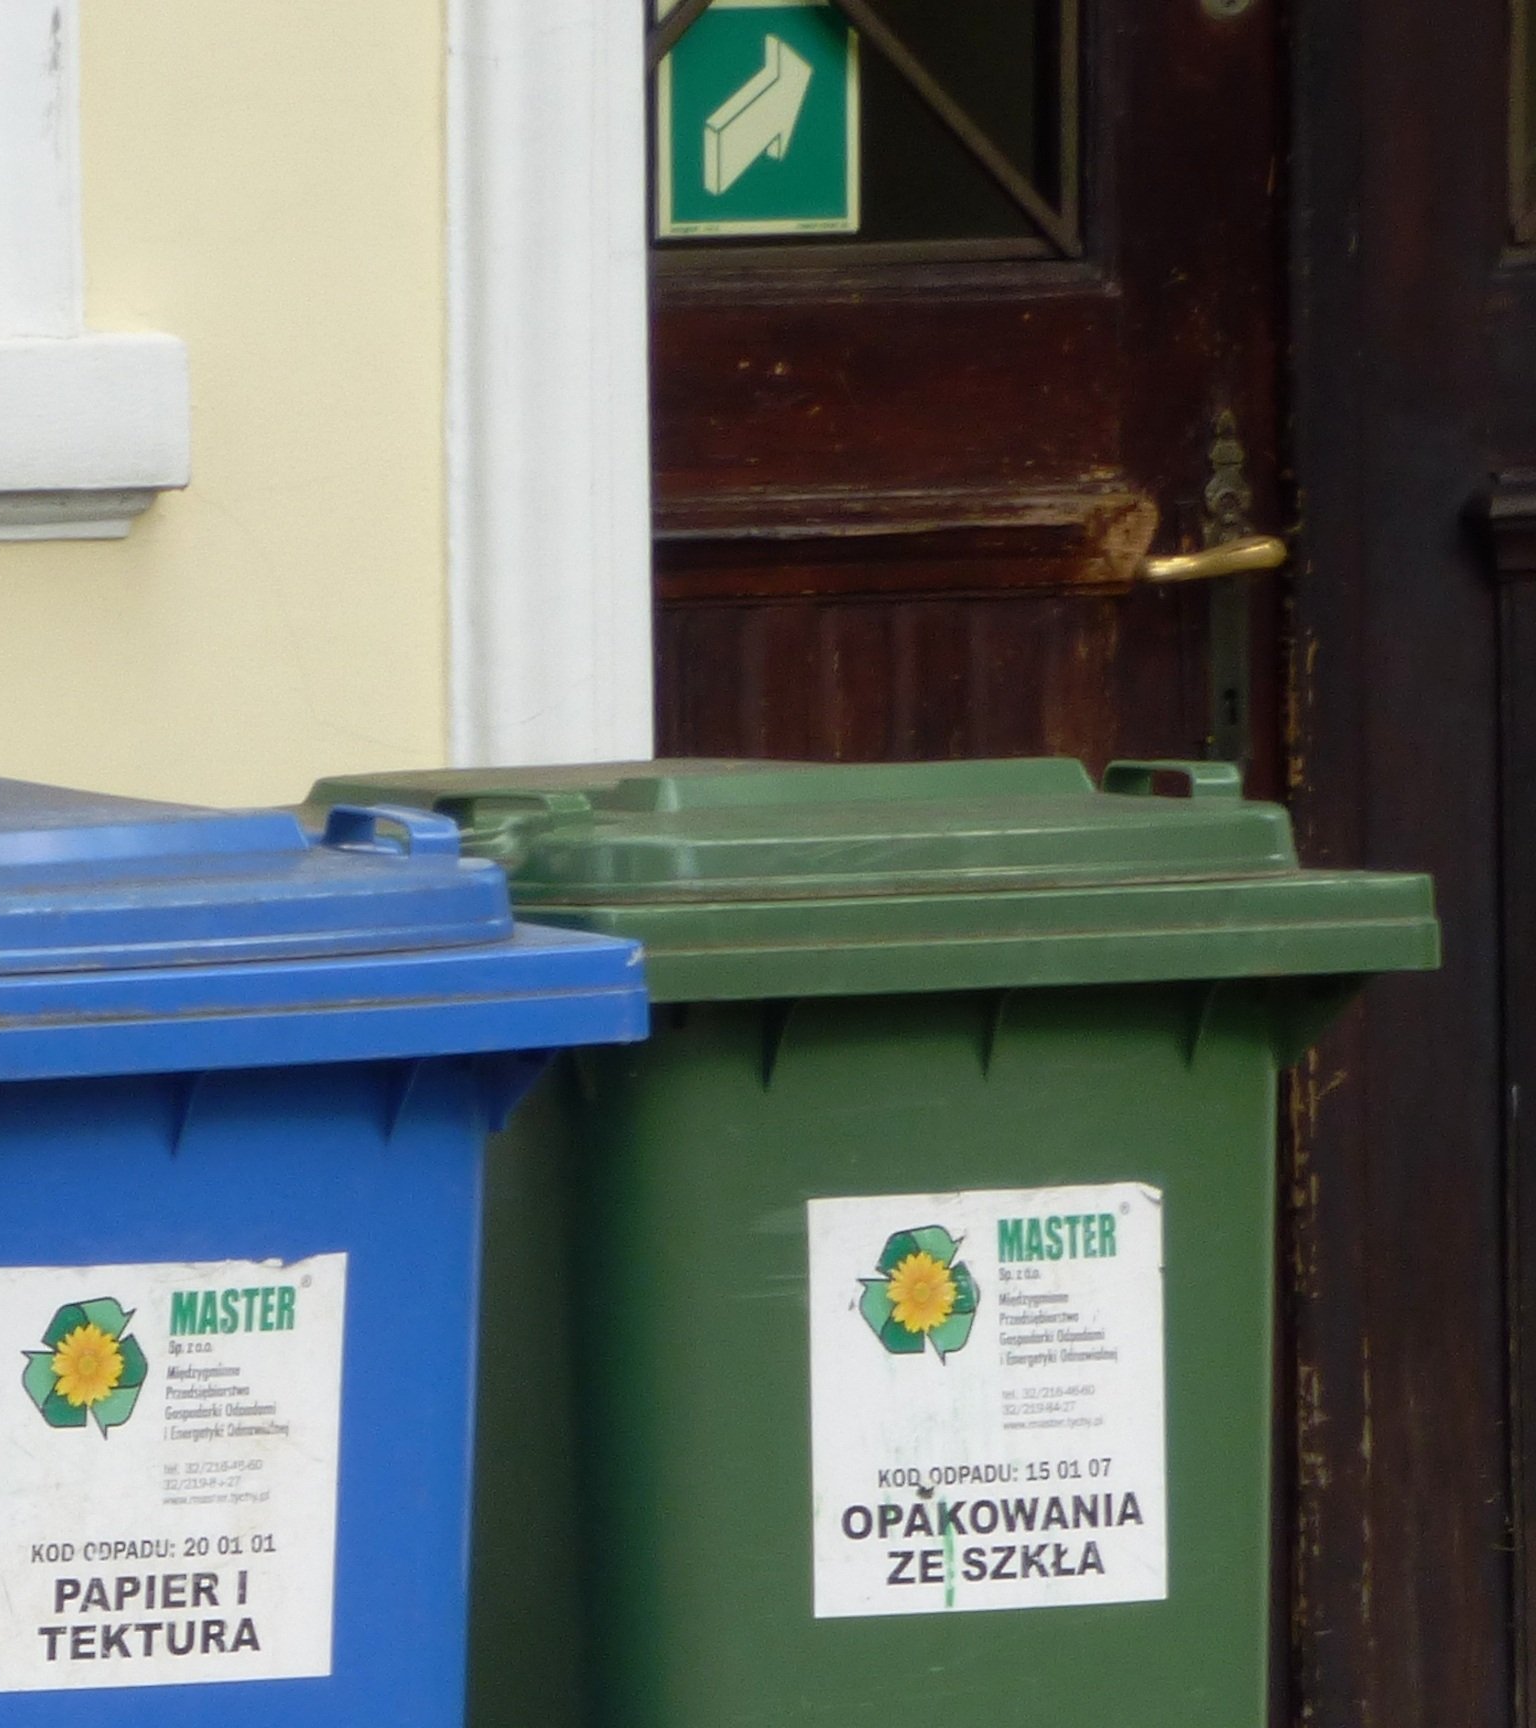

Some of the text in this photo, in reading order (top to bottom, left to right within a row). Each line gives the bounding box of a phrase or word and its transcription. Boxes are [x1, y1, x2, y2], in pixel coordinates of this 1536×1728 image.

[998, 1213, 1116, 1262] MASTER
[170, 1286, 296, 1336] MASTER
[878, 1458, 1112, 1488] KOD ODPADU: 15 01 07
[841, 1491, 1144, 1540] OPAKOWANIA
[32, 1534, 276, 1563] KOD ODPADU: 20 01 01
[886, 1540, 1106, 1585] ZE SZKŁA
[54, 1570, 248, 1614] PAPIER I
[38, 1617, 261, 1661] TEKTURA
